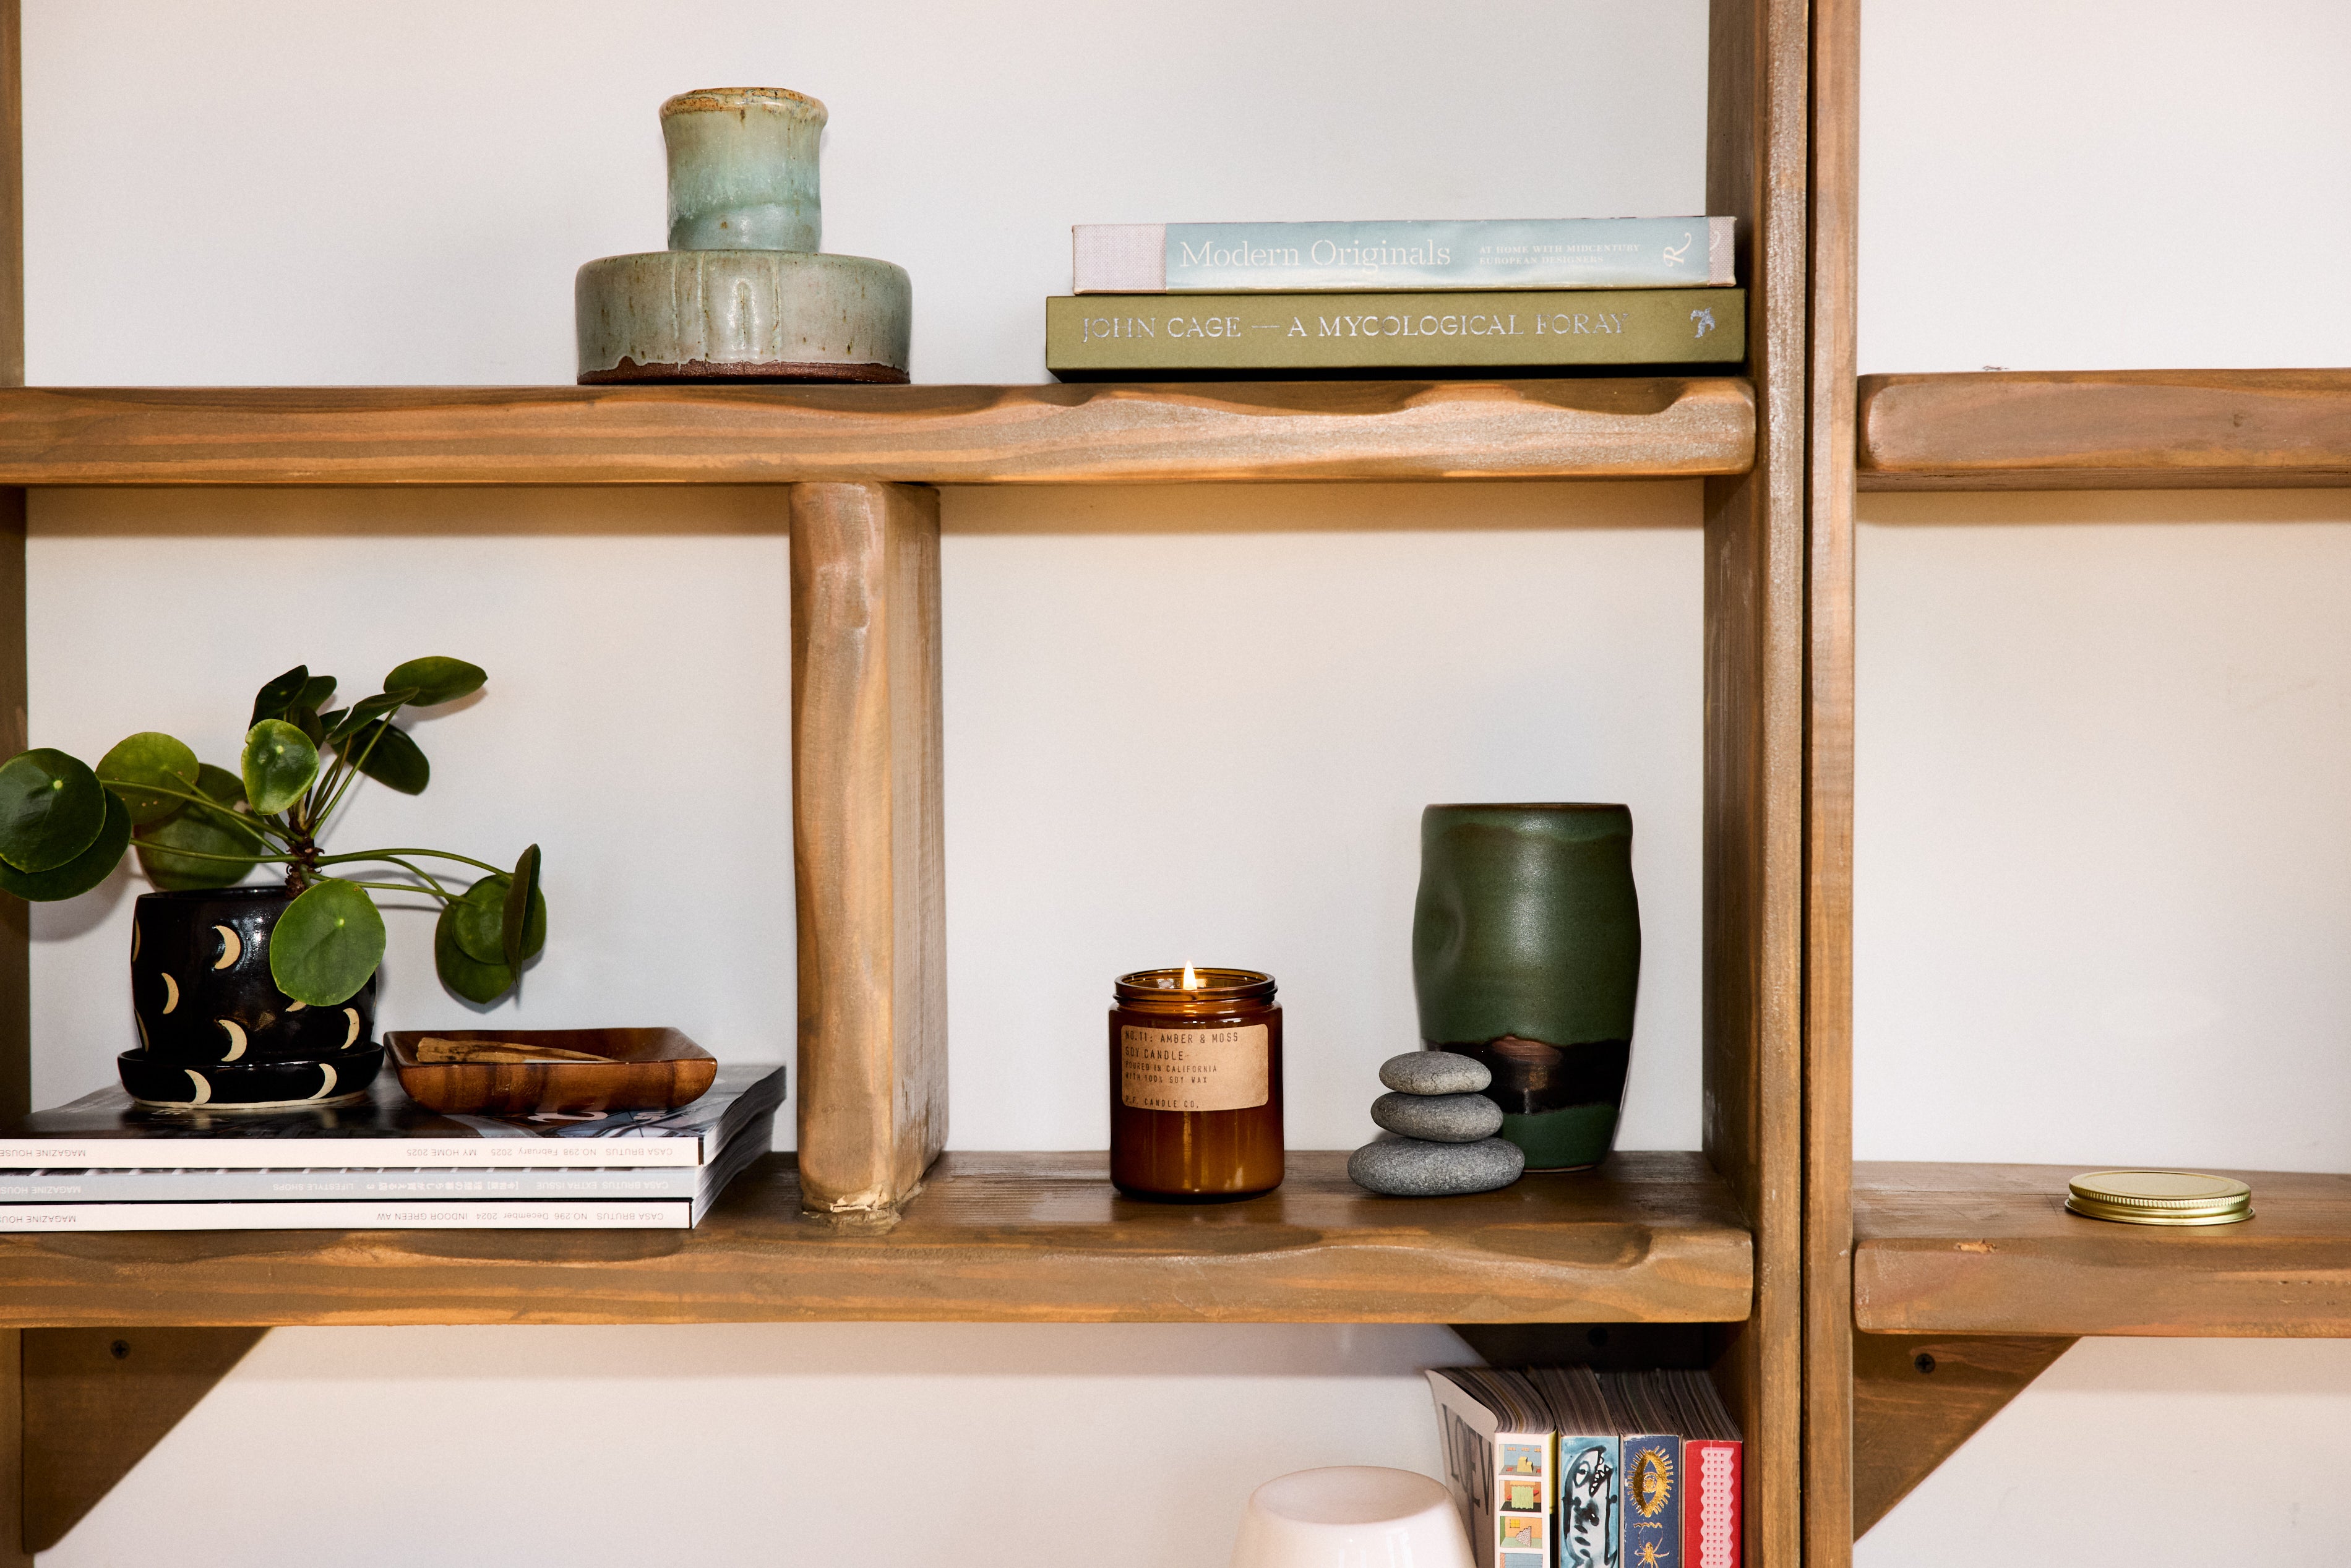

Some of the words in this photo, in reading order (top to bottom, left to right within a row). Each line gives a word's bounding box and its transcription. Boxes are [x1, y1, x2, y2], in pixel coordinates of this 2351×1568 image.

[1567, 244, 1640, 252] MIDCENTURY
[1179, 241, 1300, 267] Modern
[1311, 239, 1451, 273] Originals
[1318, 315, 1525, 336] MYCOLOGICAL
[1535, 313, 1628, 335] FORAY
[1082, 318, 1156, 343] JOHN
[1167, 317, 1241, 338] CAGE
[1287, 317, 1307, 336] A
[1125, 1030, 1153, 1042] NO.11:
[1161, 1034, 1193, 1043] AMBER
[1200, 1034, 1205, 1043] &
[1212, 1032, 1238, 1043] MOSS
[1125, 1047, 1139, 1057] SOY
[1145, 1049, 1184, 1060] CANDLE
[1125, 1061, 1150, 1071] POURED
[1145, 1099, 1177, 1107] CANDLE
[491, 1148, 513, 1156] 2025
[518, 1147, 557, 1156] February
[307, 1183, 354, 1191] LIFESTYLE
[536, 1181, 566, 1189] ISSUE
[569, 1181, 597, 1189] EXTRA
[602, 1181, 641, 1189] BRUTUS
[643, 1181, 669, 1189] CASA
[376, 1212, 391, 1220] AW
[395, 1212, 427, 1220] GREEN
[430, 1212, 468, 1220] INDOOR
[476, 1212, 497, 1220] 2024
[503, 1212, 548, 1220] December
[554, 1212, 588, 1220] NO.296
[596, 1212, 635, 1220] BRUTUS
[638, 1212, 664, 1220] CASA
